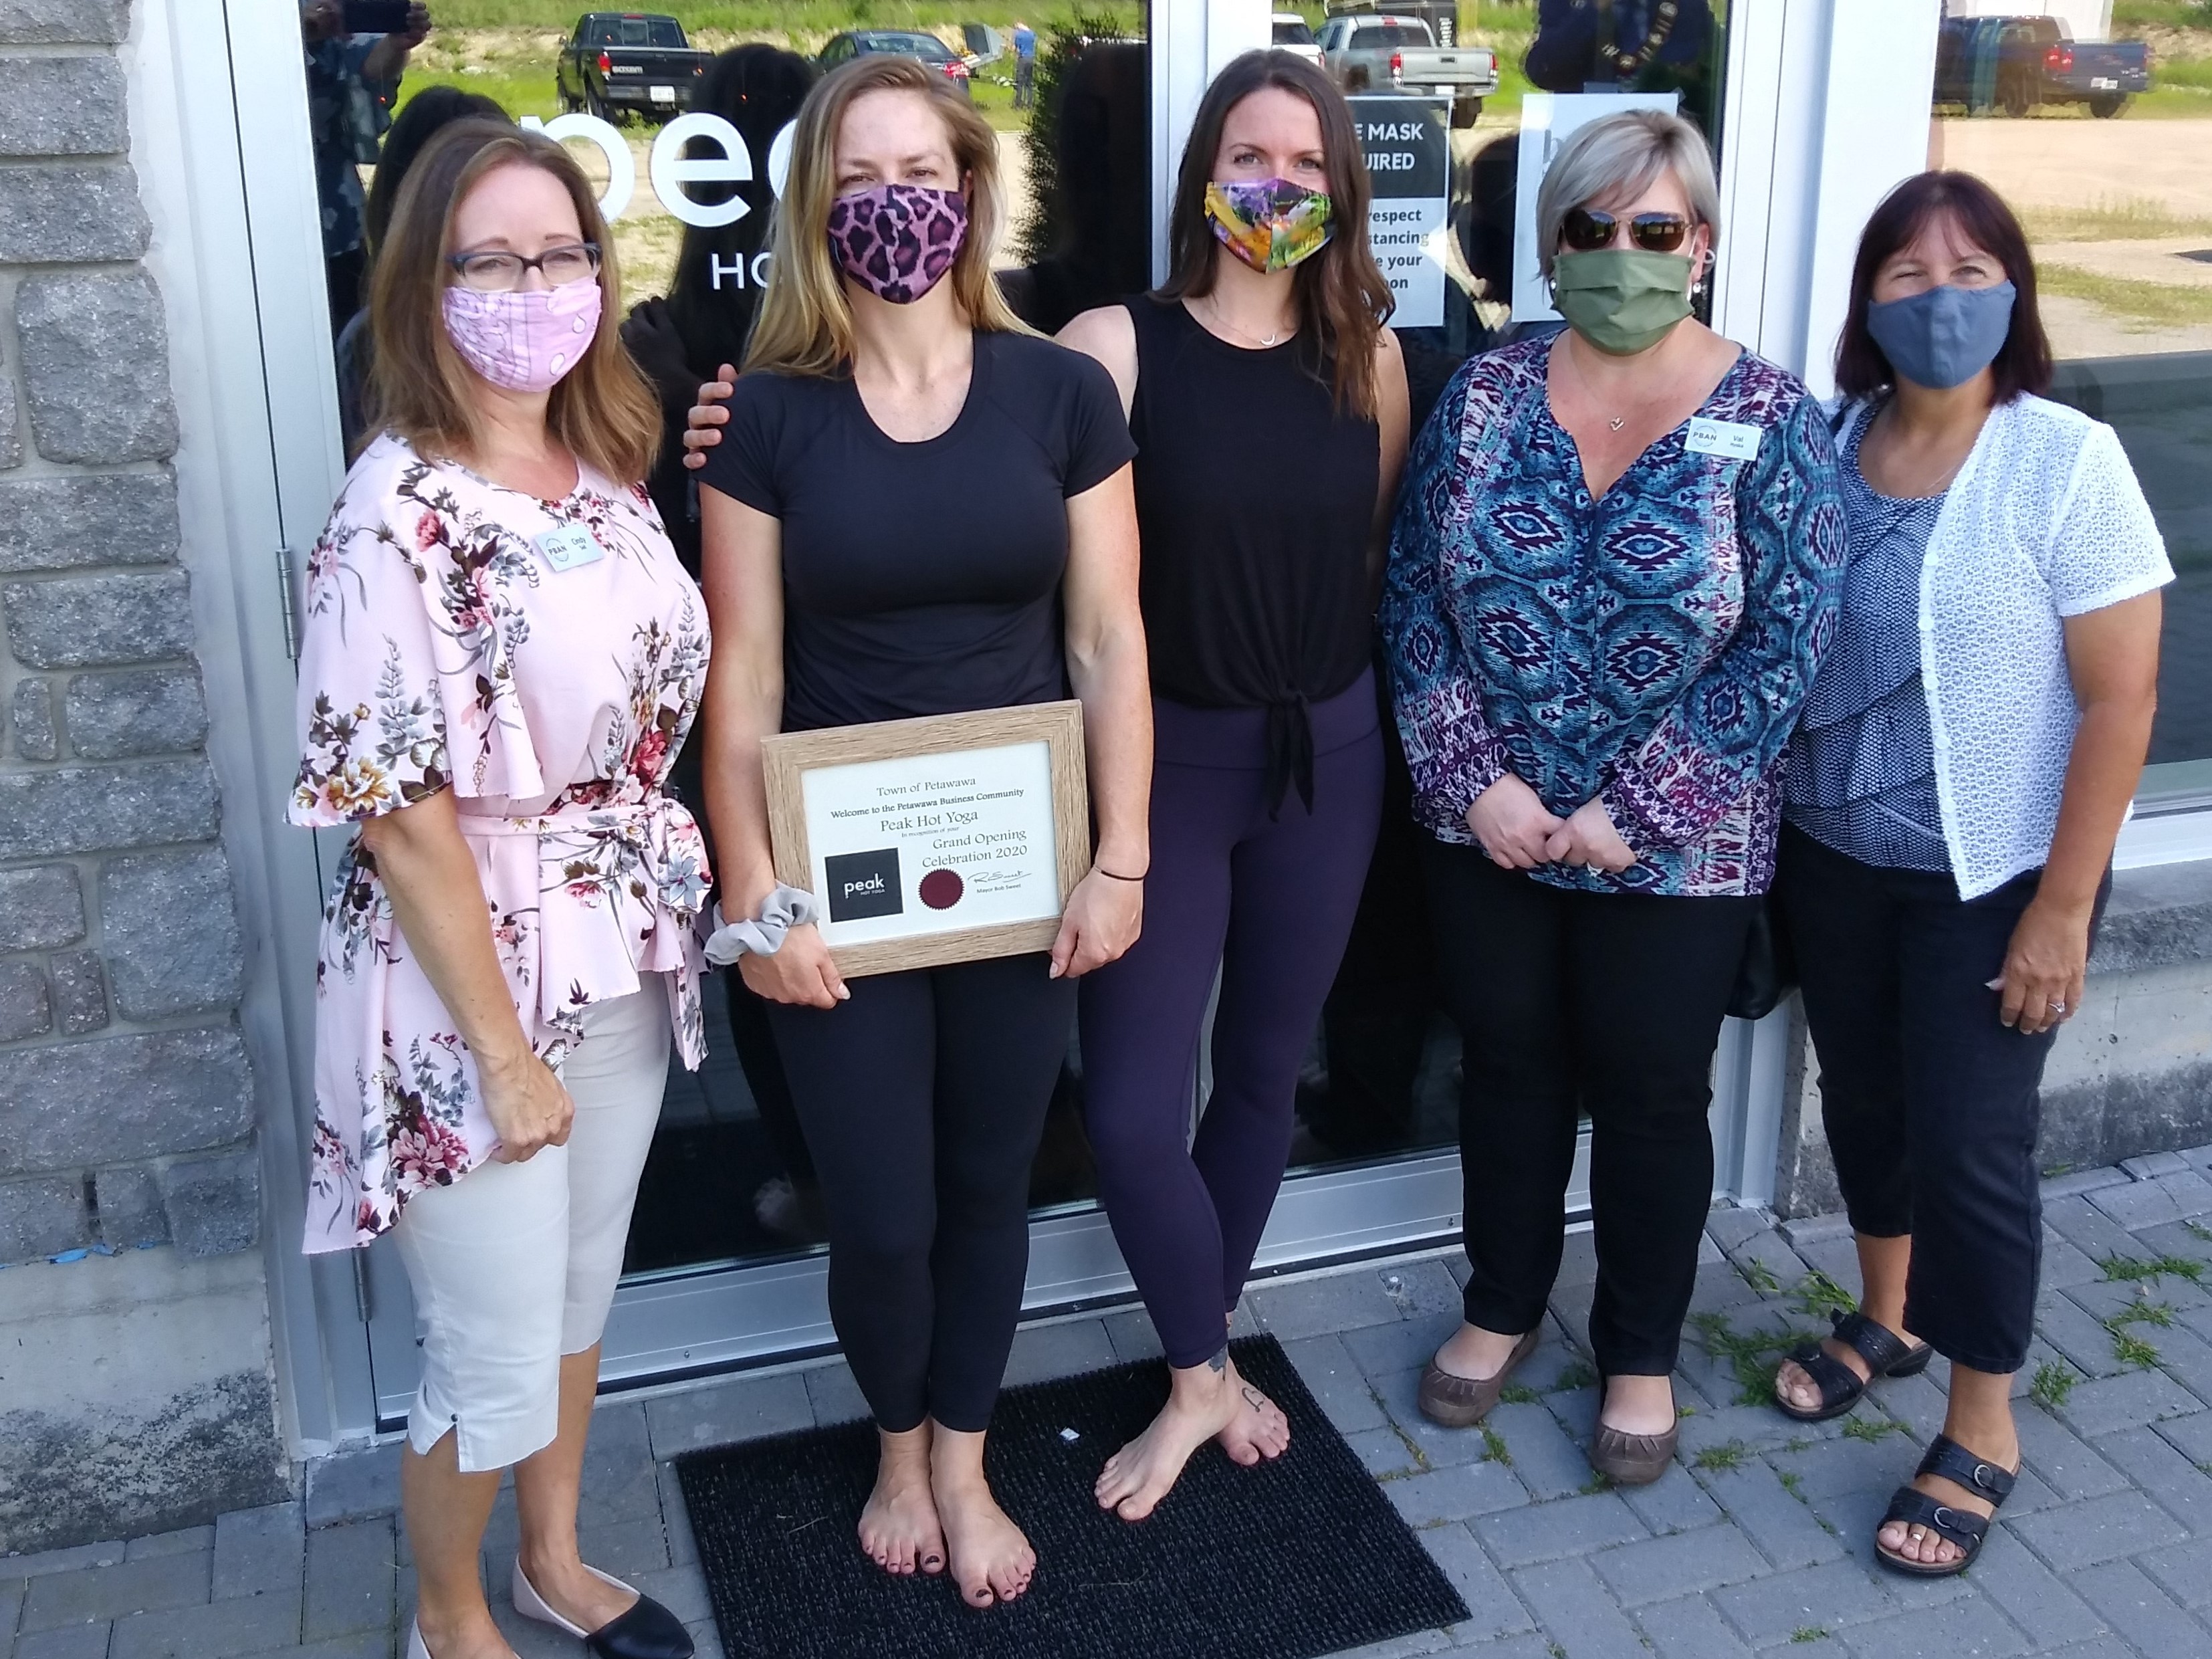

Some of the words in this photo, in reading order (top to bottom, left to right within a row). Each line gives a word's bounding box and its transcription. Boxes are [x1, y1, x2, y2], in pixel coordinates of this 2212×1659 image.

[1367, 122, 1424, 141] MASK
[1388, 255, 1423, 270] your
[1387, 278, 1409, 289] on
[1693, 431, 1717, 441] PBAN
[877, 785, 907, 796] Town
[909, 782, 921, 792] of
[925, 778, 976, 791] Petawawa
[831, 808, 870, 818] Welcome
[881, 804, 895, 812] the
[897, 800, 938, 811] Petawawa
[939, 794, 975, 806] Business
[976, 788, 1024, 801] Community
[881, 816, 913, 832] Peak
[917, 814, 941, 827] Hot
[946, 810, 978, 825] Yoga
[933, 834, 972, 849] Grand
[974, 829, 1027, 846] Opening
[922, 851, 992, 868] Celebration
[996, 845, 1028, 859] 2020
[845, 873, 885, 899] peak
